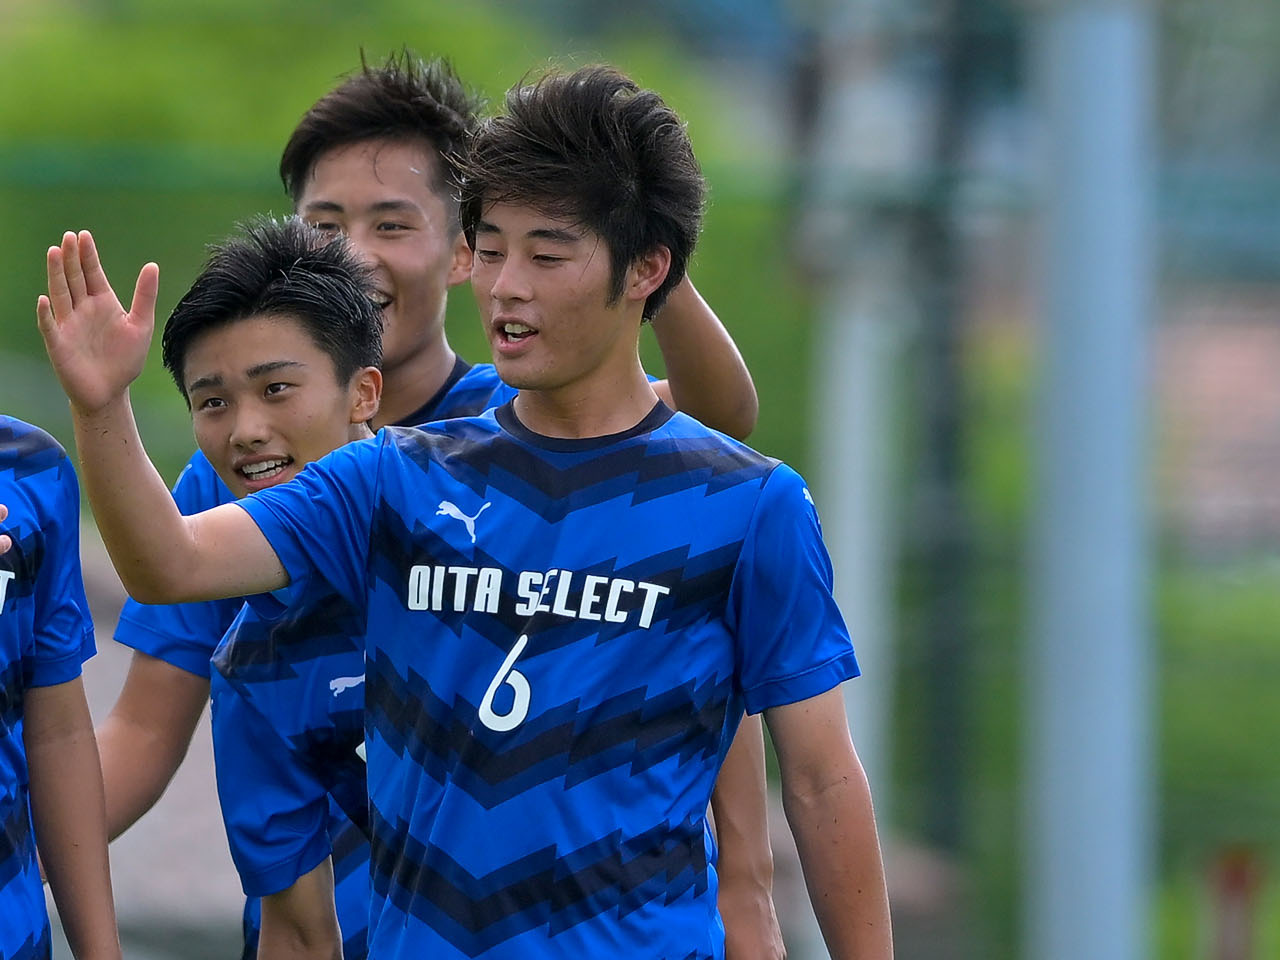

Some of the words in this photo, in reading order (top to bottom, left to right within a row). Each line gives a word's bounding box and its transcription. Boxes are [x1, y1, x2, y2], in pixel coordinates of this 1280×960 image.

[407, 565, 503, 614] OITA
[515, 568, 670, 629] SELECT
[478, 634, 531, 732] 6
